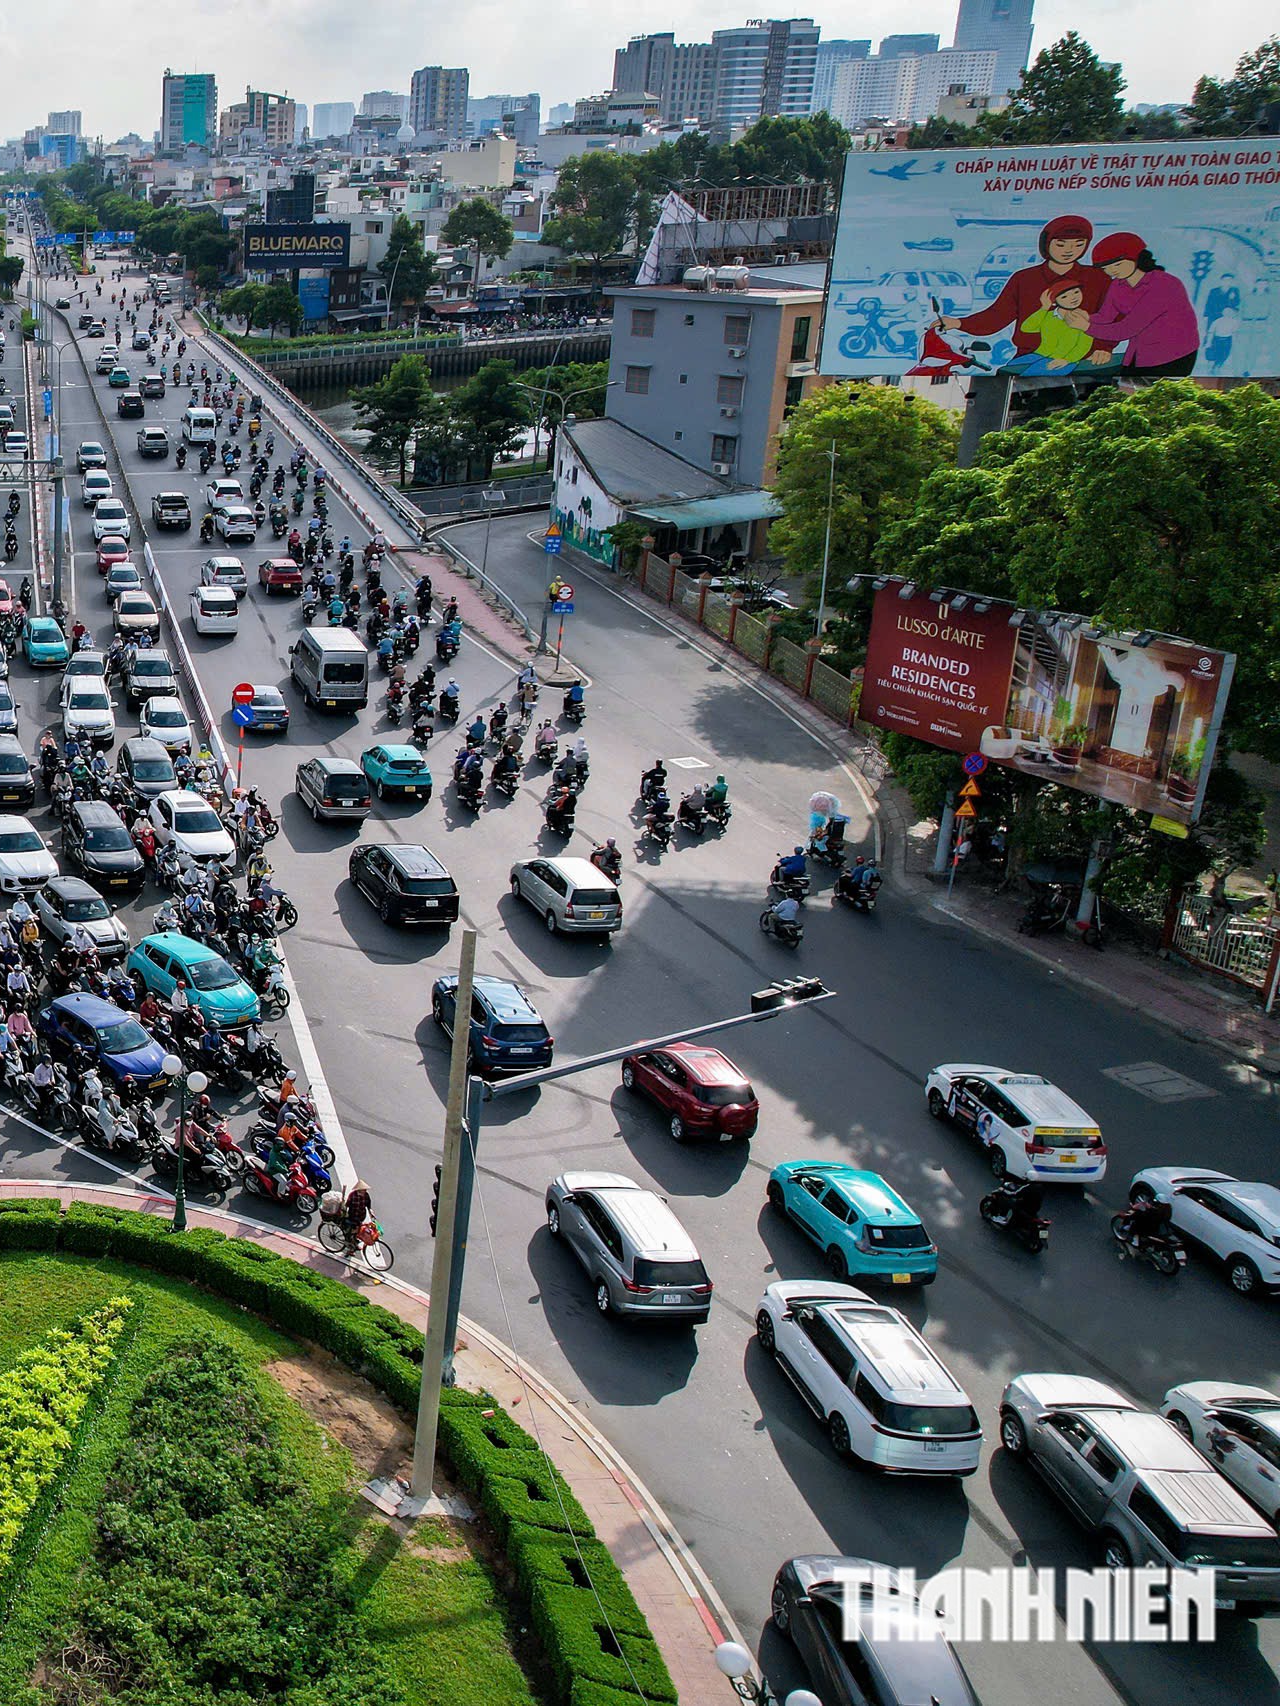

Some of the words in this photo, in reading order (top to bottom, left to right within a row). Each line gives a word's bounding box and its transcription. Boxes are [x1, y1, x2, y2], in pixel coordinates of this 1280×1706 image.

[955, 157, 993, 174] CHẤP
[997, 157, 1038, 173] HÀNH
[1041, 155, 1077, 173] LUẬT
[1081, 153, 1100, 170] VỀ
[1103, 153, 1139, 171] TRẬT
[1142, 154, 1163, 171] TỰ
[1164, 154, 1186, 167] AN
[1190, 151, 1231, 167] TOÀN
[1234, 151, 1272, 165] GIAO
[983, 177, 1012, 192] XÂY
[1014, 177, 1055, 193] DỰNG
[1058, 172, 1087, 189] NẾP
[1090, 172, 1131, 189] SỐNG
[1135, 171, 1165, 188] VĂN
[1168, 170, 1199, 187] HÓA
[1203, 171, 1240, 186] GIAO
[249, 236, 344, 251] BLUEMARQ
[897, 615, 938, 638] LUSSO
[941, 625, 986, 650] d'ARTE
[902, 647, 970, 676] BRANDED
[877, 678, 892, 688] TIÊU
[892, 683, 916, 695] CHUẨN
[917, 687, 940, 702] KHÁCH
[941, 697, 956, 707] SẠN
[956, 700, 977, 713] QUỐC
[979, 705, 989, 715] TẾ
[891, 665, 976, 700] RESIDENCES
